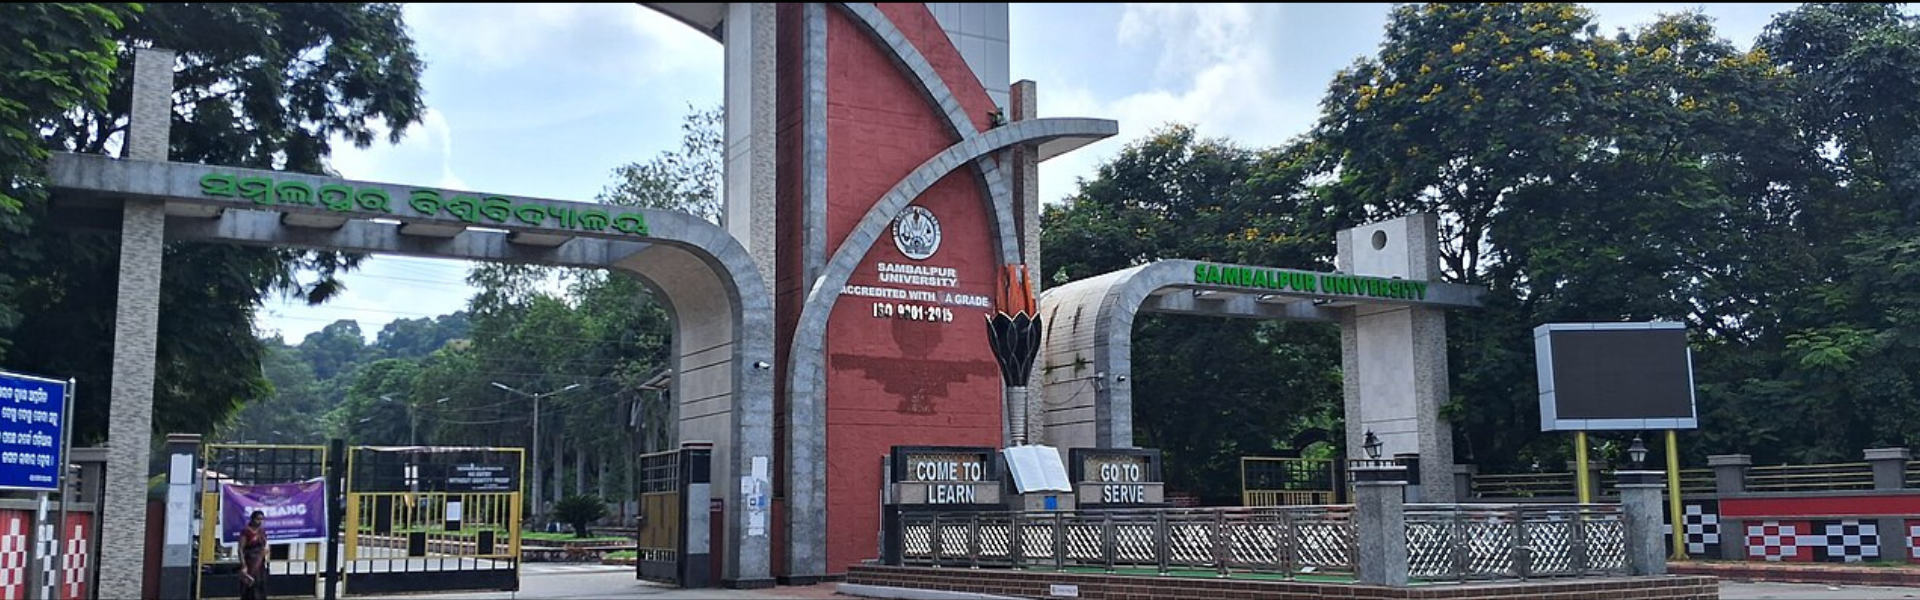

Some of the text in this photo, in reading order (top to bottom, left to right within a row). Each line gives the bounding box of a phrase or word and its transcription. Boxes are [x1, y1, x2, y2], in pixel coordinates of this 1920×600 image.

[878, 262, 956, 278] SAMBALPUR
[879, 273, 958, 287] UNIVERSITY
[1194, 263, 1428, 300] SAMBALPUR UNIVERSITY
[840, 285, 989, 307] ACCREDITED WITH A GRADE
[917, 461, 981, 481] COME TO
[1101, 462, 1139, 482] GO TO
[928, 484, 975, 504] LEARN
[1104, 484, 1144, 503] SERVE
